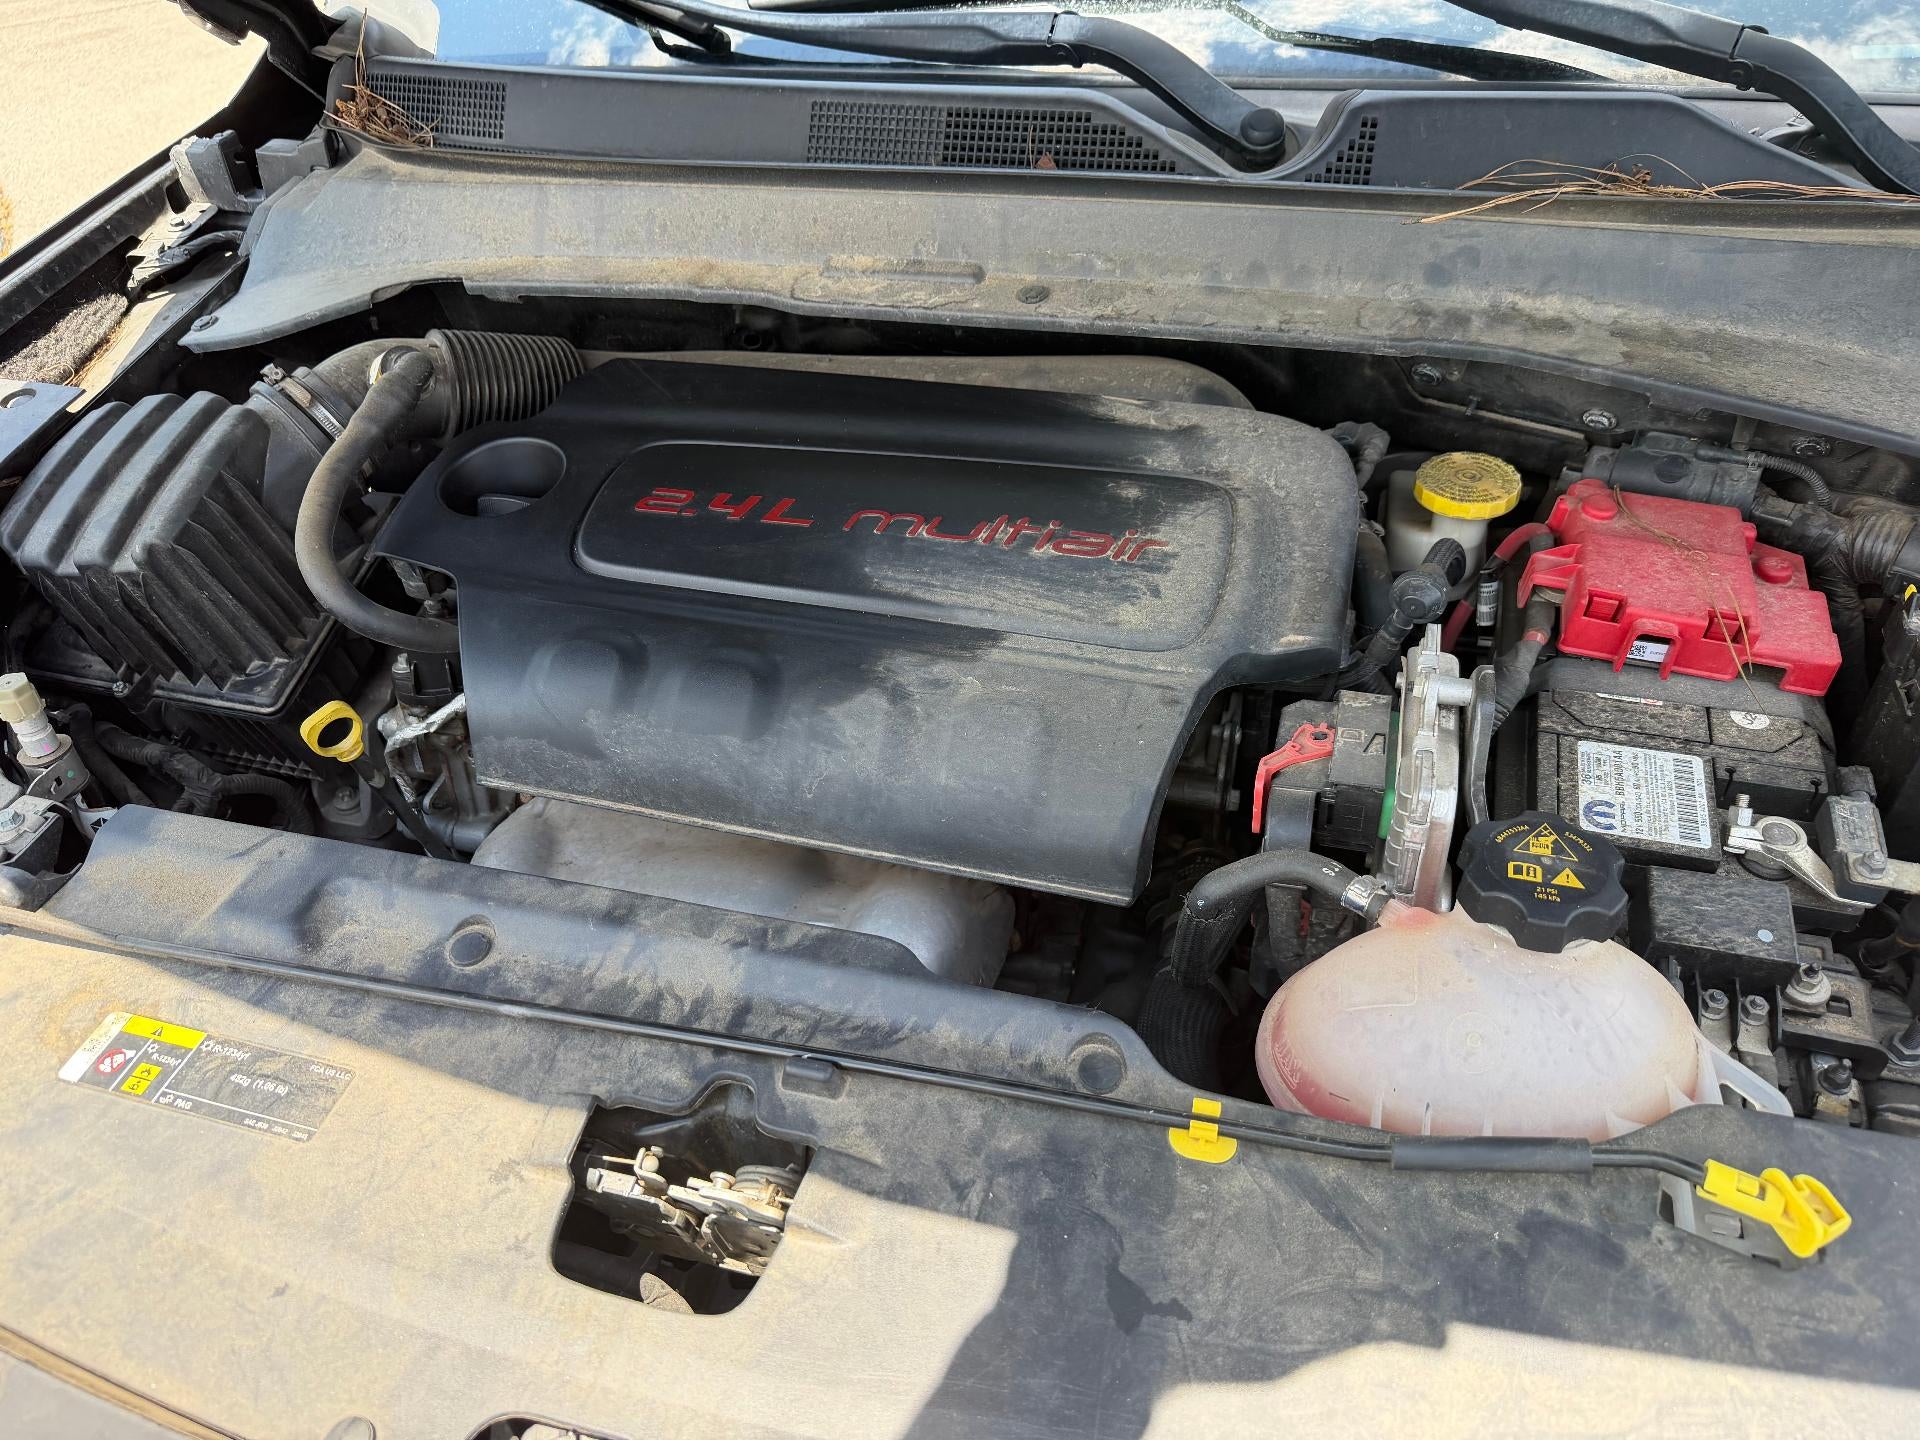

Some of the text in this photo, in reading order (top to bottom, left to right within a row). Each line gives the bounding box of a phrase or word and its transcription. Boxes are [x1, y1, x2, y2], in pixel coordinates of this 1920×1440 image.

[634, 486, 1167, 562] 2.4L multiair
[325, 1068, 335, 1076] US
